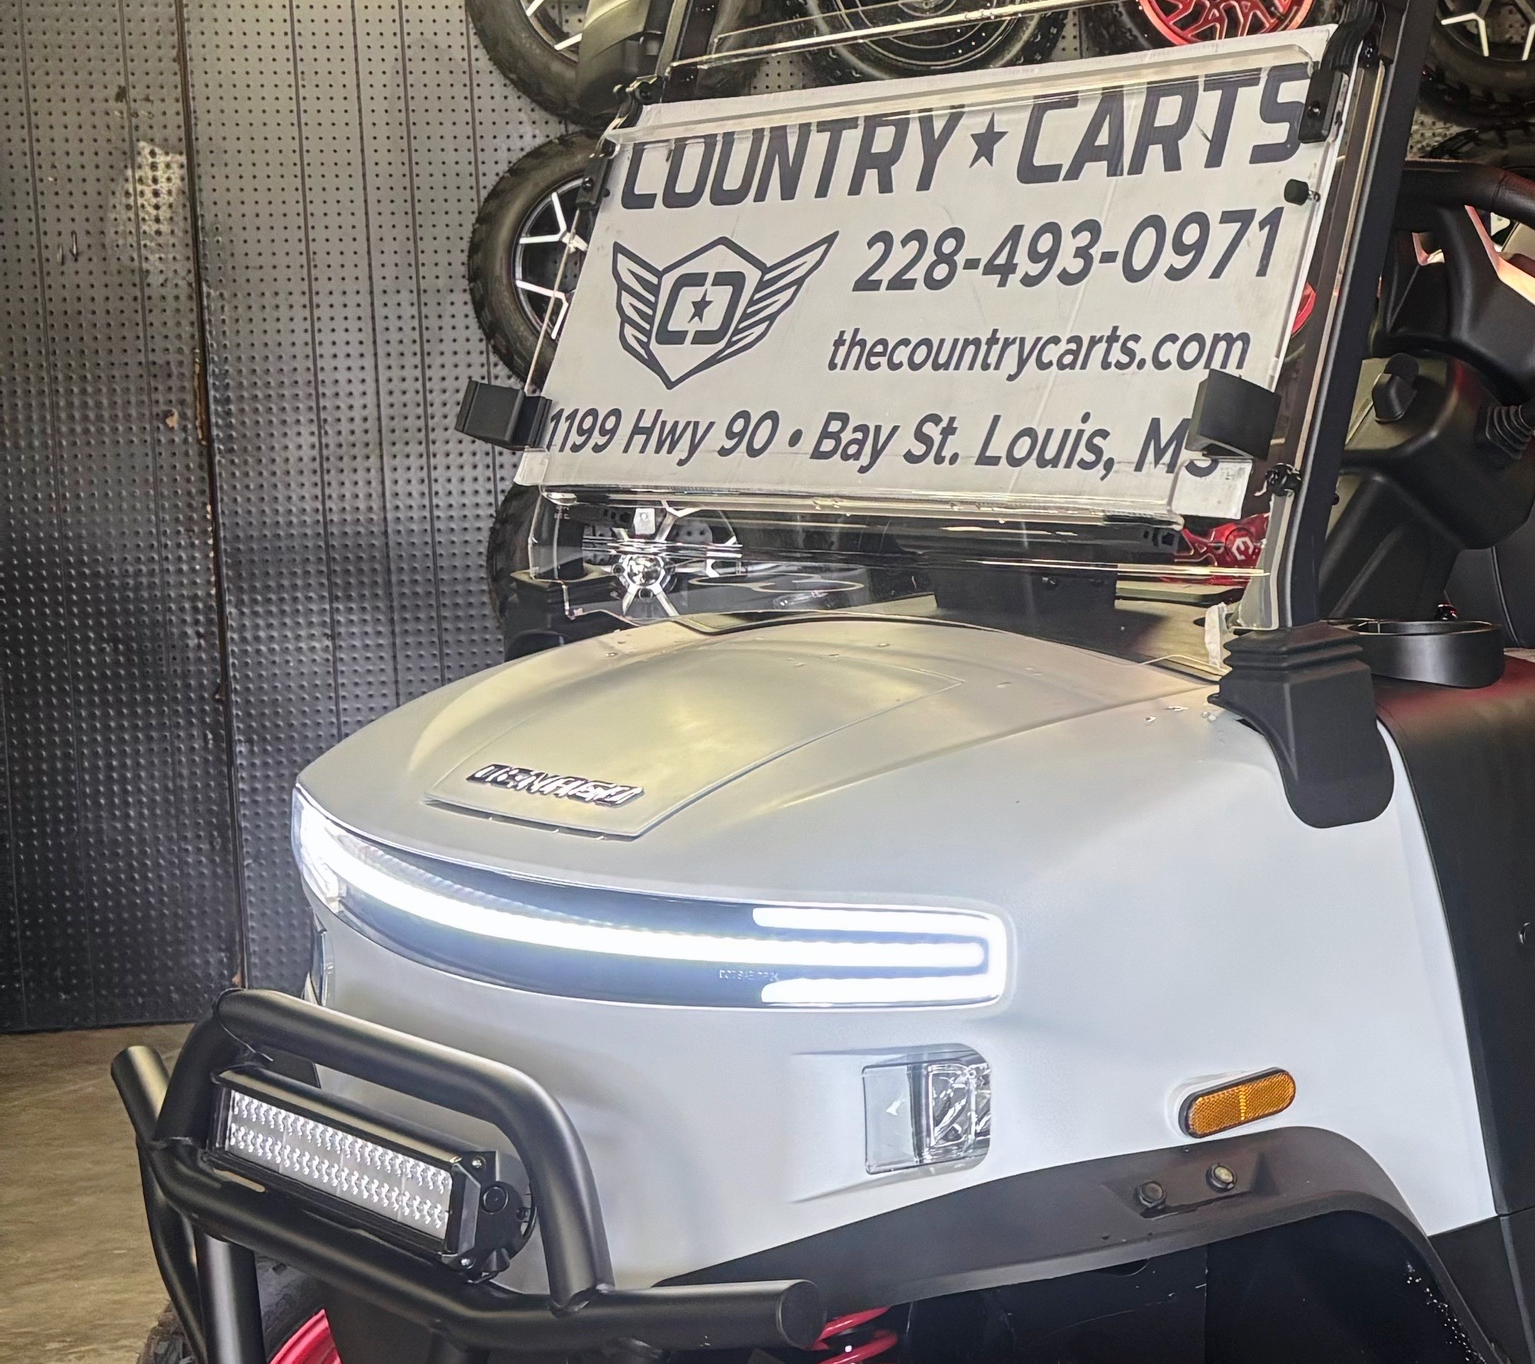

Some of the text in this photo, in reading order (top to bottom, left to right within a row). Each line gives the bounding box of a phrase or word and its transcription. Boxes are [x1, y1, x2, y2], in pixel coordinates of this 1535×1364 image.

[621, 61, 1310, 210] COUNTRY CARTS
[852, 207, 1284, 292] 228-493-0971
[827, 327, 1252, 382] thecountrycarts.com
[546, 407, 622, 454] 1199
[622, 408, 716, 467] Hwy
[717, 409, 780, 458] 90
[809, 411, 899, 474] Bay
[903, 412, 960, 466] St.
[974, 411, 1115, 480] Louis,
